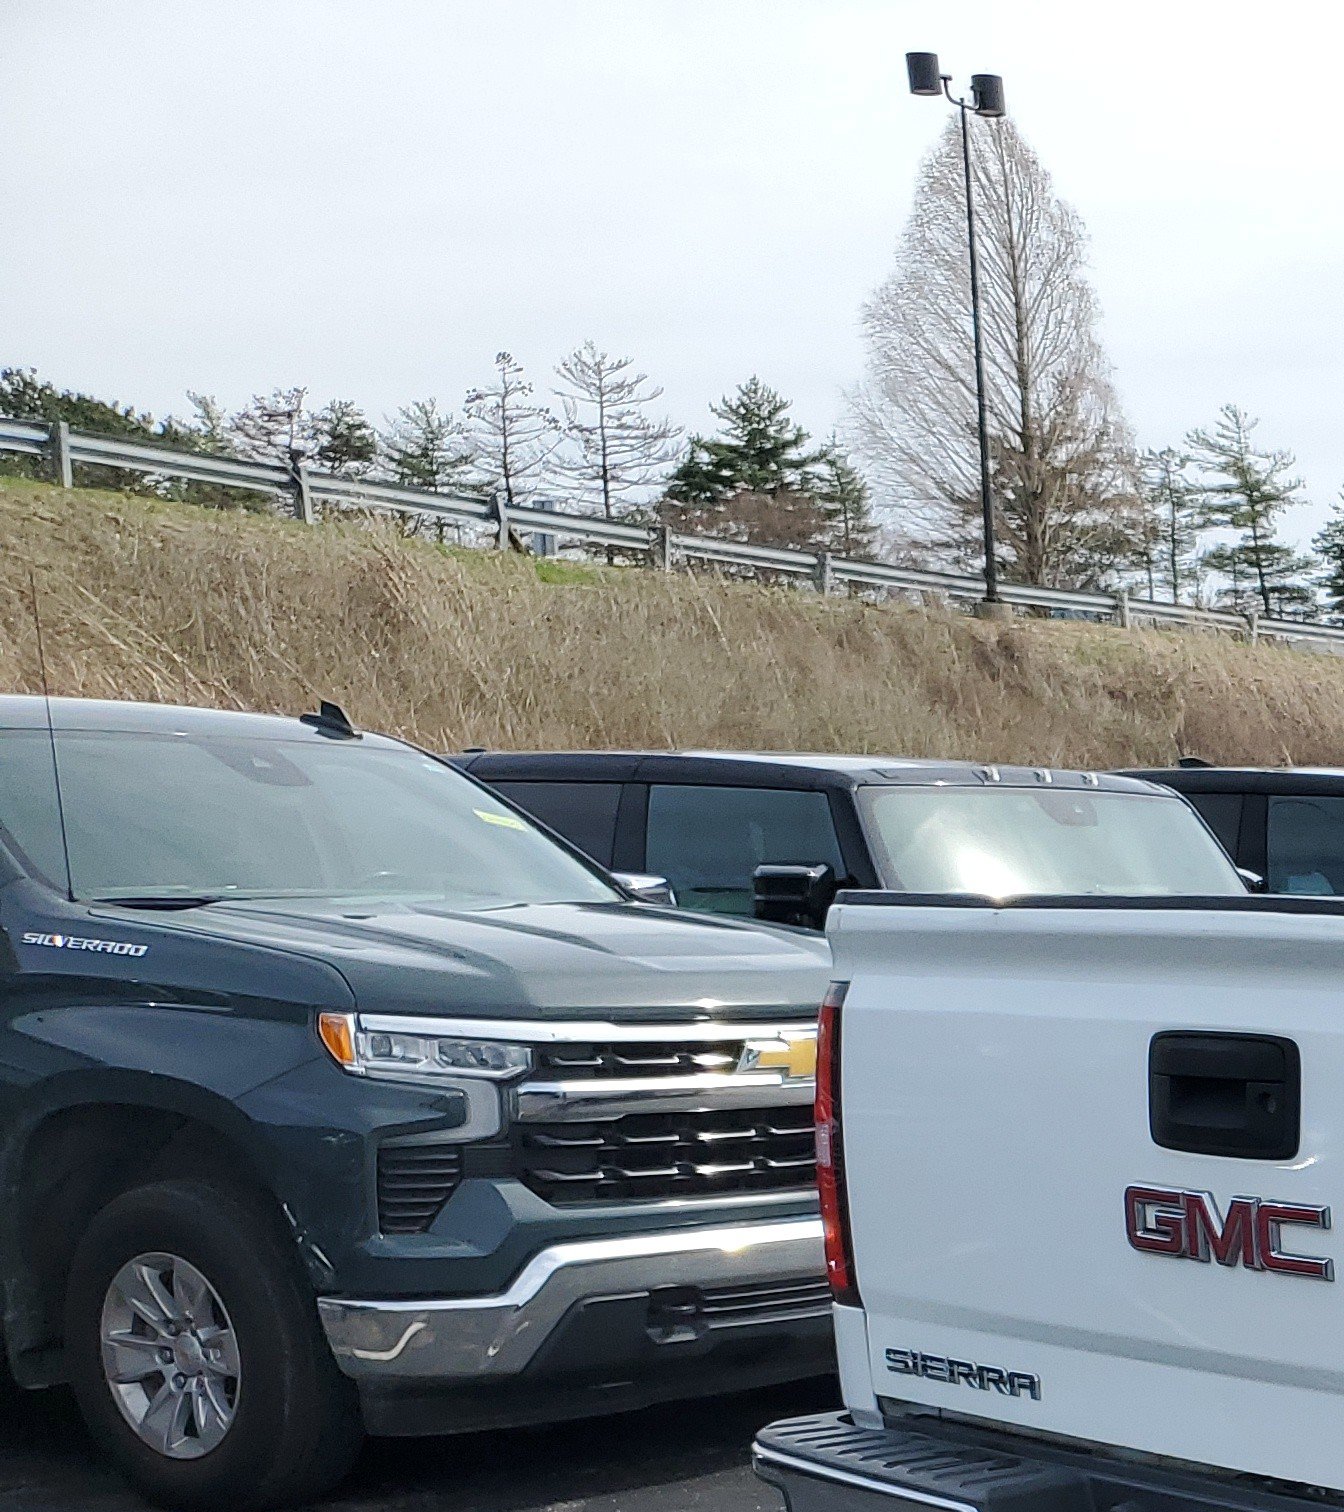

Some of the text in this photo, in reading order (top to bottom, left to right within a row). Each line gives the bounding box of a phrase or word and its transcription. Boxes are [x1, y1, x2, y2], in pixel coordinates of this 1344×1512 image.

[21, 932, 149, 957] SILVERADO
[1124, 1181, 1335, 1282] GMC
[885, 1348, 1042, 1400] SIERRA
